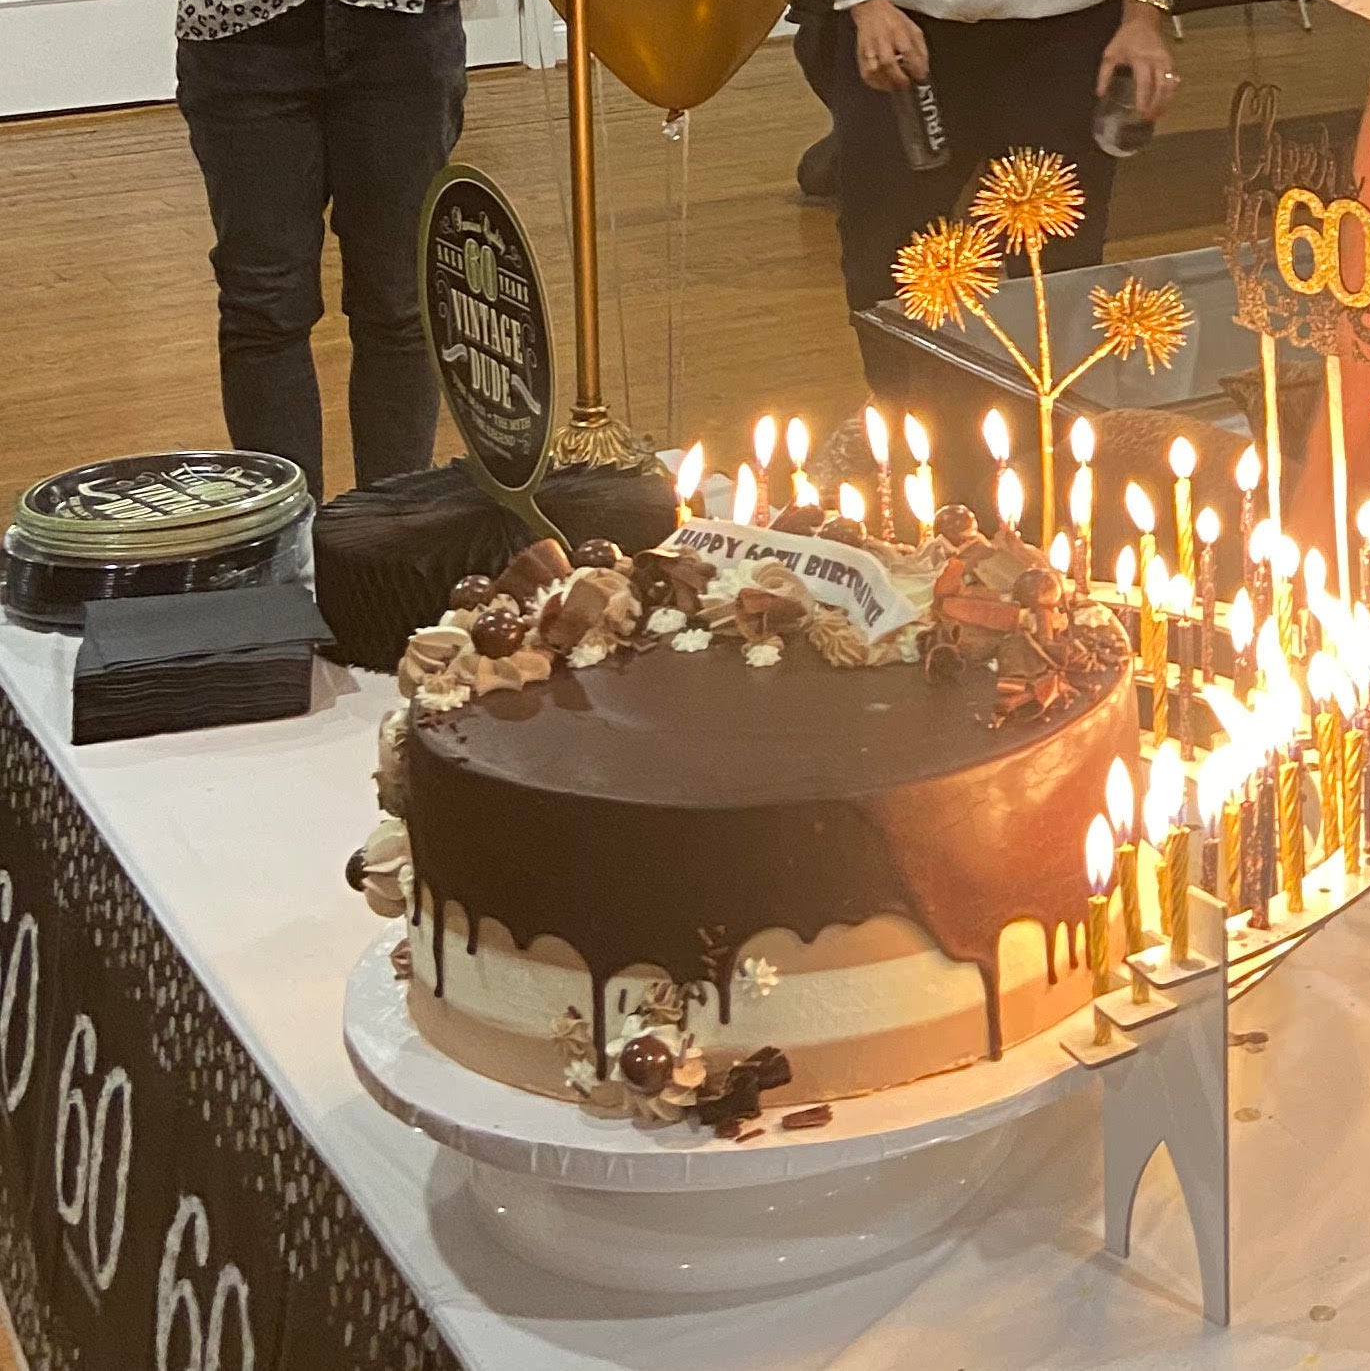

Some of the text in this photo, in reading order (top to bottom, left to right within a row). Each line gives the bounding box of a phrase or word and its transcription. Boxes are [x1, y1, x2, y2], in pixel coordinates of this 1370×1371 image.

[917, 84, 946, 151] TRULY
[464, 237, 498, 302] 60
[450, 287, 524, 365] VINTAGE
[468, 346, 512, 409] DUDE
[128, 483, 212, 515] VINTAG
[674, 528, 743, 559] HAPPY
[0, 869, 39, 1112] 0
[56, 1013, 132, 1290] 60
